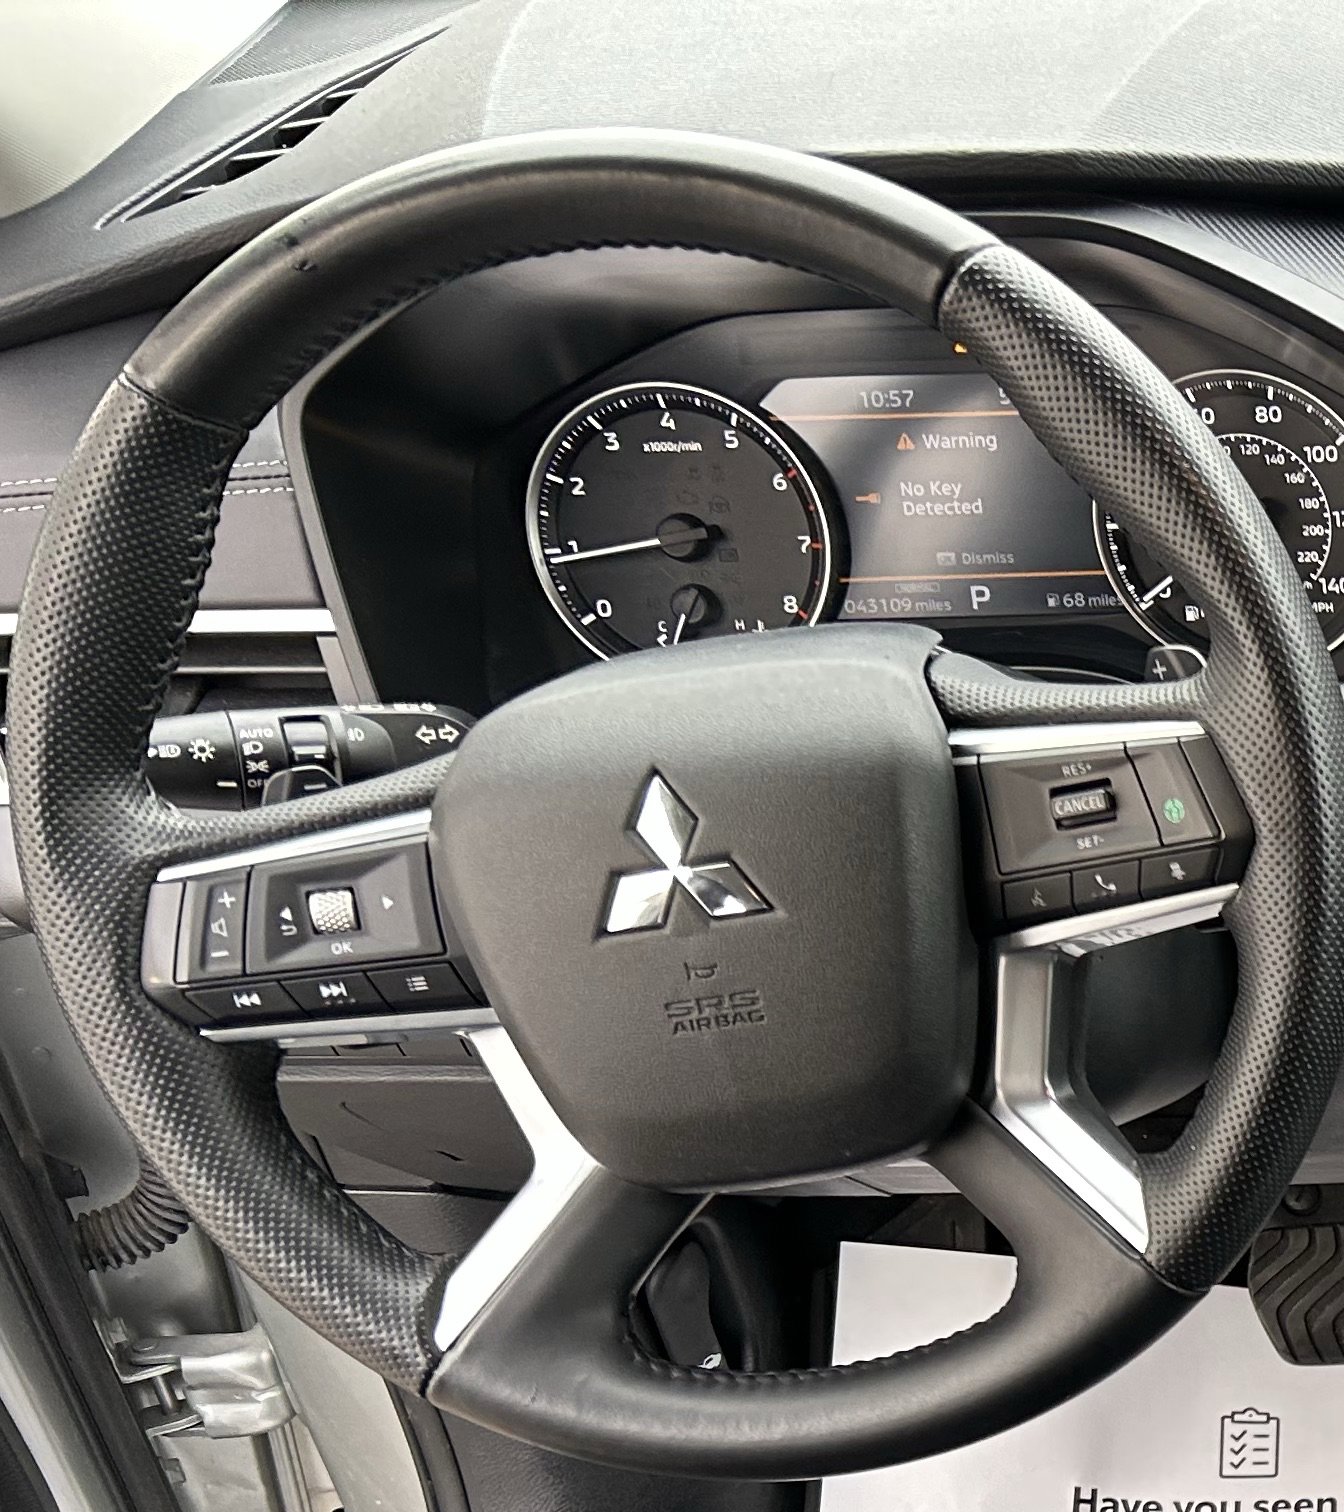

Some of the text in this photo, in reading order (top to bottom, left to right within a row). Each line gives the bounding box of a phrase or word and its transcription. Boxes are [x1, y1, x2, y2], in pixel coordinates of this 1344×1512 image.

[860, 389, 914, 409] 10:57
[660, 412, 676, 430] 4
[1255, 405, 1283, 424] 80
[603, 431, 620, 451] 3
[724, 430, 740, 449] 5
[922, 432, 998, 452] Warning
[1239, 443, 1260, 455] 120
[1303, 445, 1338, 463] 100
[1264, 453, 1285, 466] 140
[569, 477, 586, 496] 2
[772, 473, 788, 491] 6
[1284, 472, 1305, 485] 160
[900, 481, 962, 499] No Key
[902, 499, 983, 517] Detected
[1299, 498, 1320, 510] 180
[1302, 524, 1324, 537] 200
[798, 535, 812, 554] 7
[961, 552, 1015, 565] Dismiss
[1297, 551, 1319, 564] 220
[783, 595, 799, 614] 8
[844, 598, 952, 614] 043109 miles
[970, 585, 991, 610] P
[1062, 592, 1124, 608] 68 miles
[596, 599, 613, 618] 0
[658, 620, 667, 633] C
[735, 620, 746, 631] H
[240, 727, 273, 739] AUTO
[1061, 762, 1092, 777] RES+
[1054, 794, 1105, 815] CANCEL
[331, 942, 353, 955] OK
[664, 990, 760, 1018] SRS
[672, 1009, 766, 1035] AIRBAG
